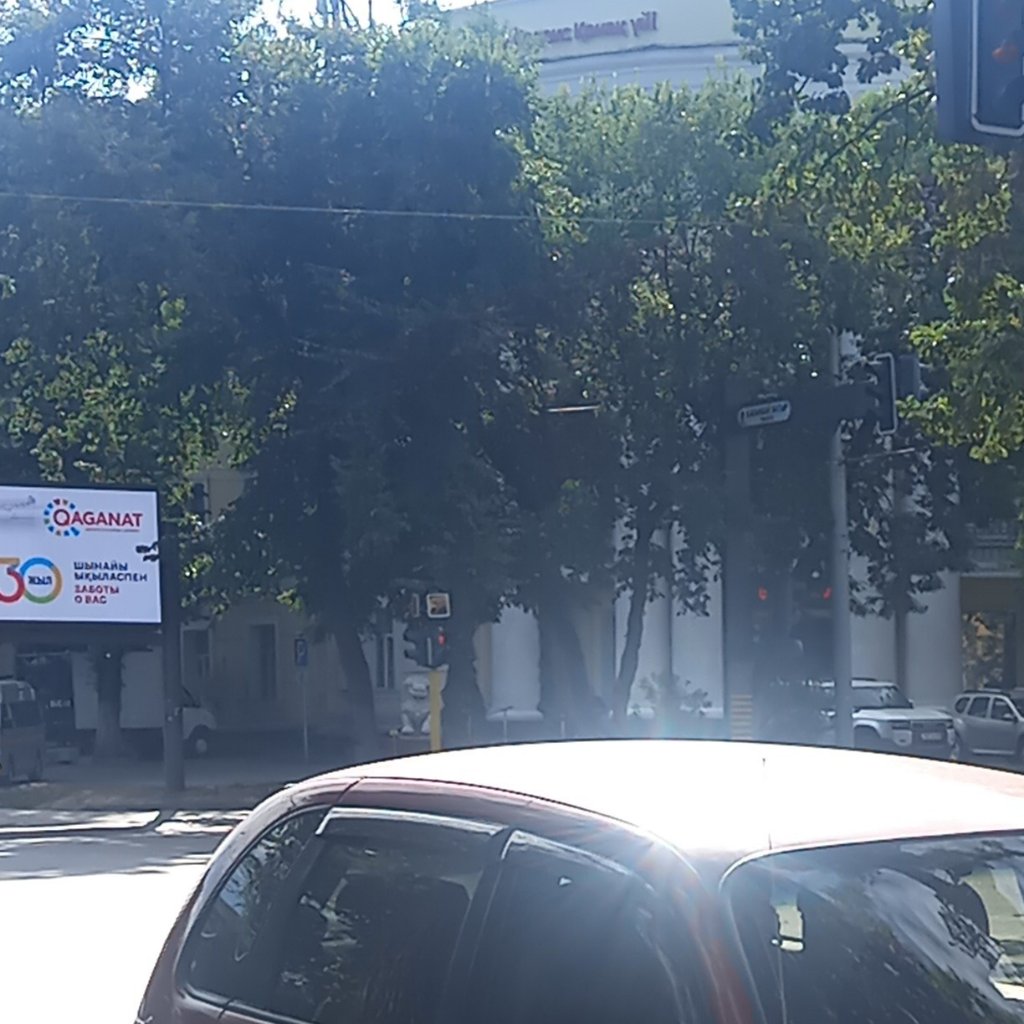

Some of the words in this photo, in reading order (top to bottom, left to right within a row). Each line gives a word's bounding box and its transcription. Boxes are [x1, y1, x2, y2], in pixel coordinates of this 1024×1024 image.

[53, 508, 144, 528] QAGANAT
[74, 584, 120, 595] ЗАБОТЫ
[74, 595, 83, 604] О
[85, 595, 107, 605] ВАС
